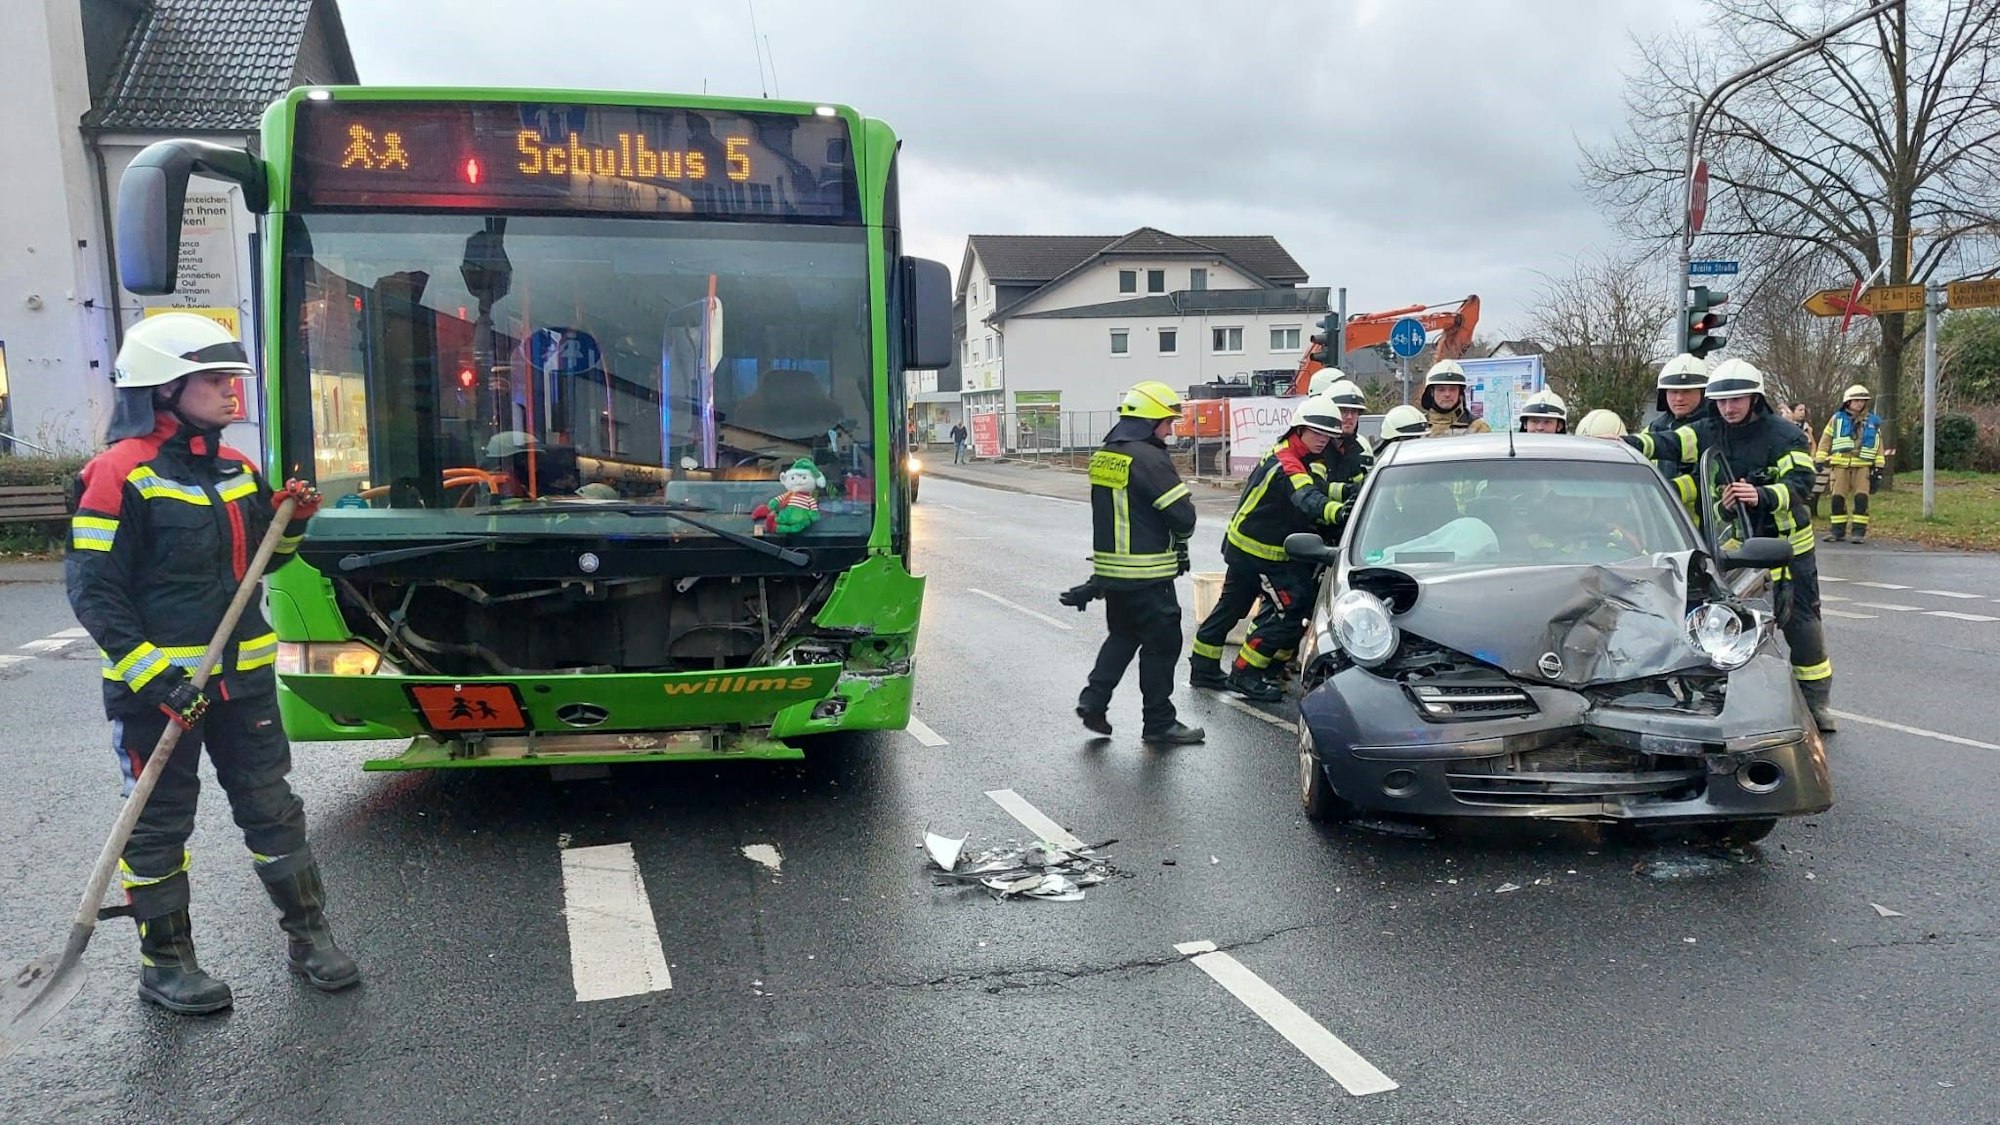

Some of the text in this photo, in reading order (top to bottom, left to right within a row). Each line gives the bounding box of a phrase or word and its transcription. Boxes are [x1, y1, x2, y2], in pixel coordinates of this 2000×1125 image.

[518, 129, 750, 180] Schulbus 5
[197, 206, 226, 215] Ihnen
[182, 279, 196, 287] Oui
[184, 295, 197, 303] Tru
[1909, 291, 1922, 303] 56
[663, 676, 813, 695] willms
